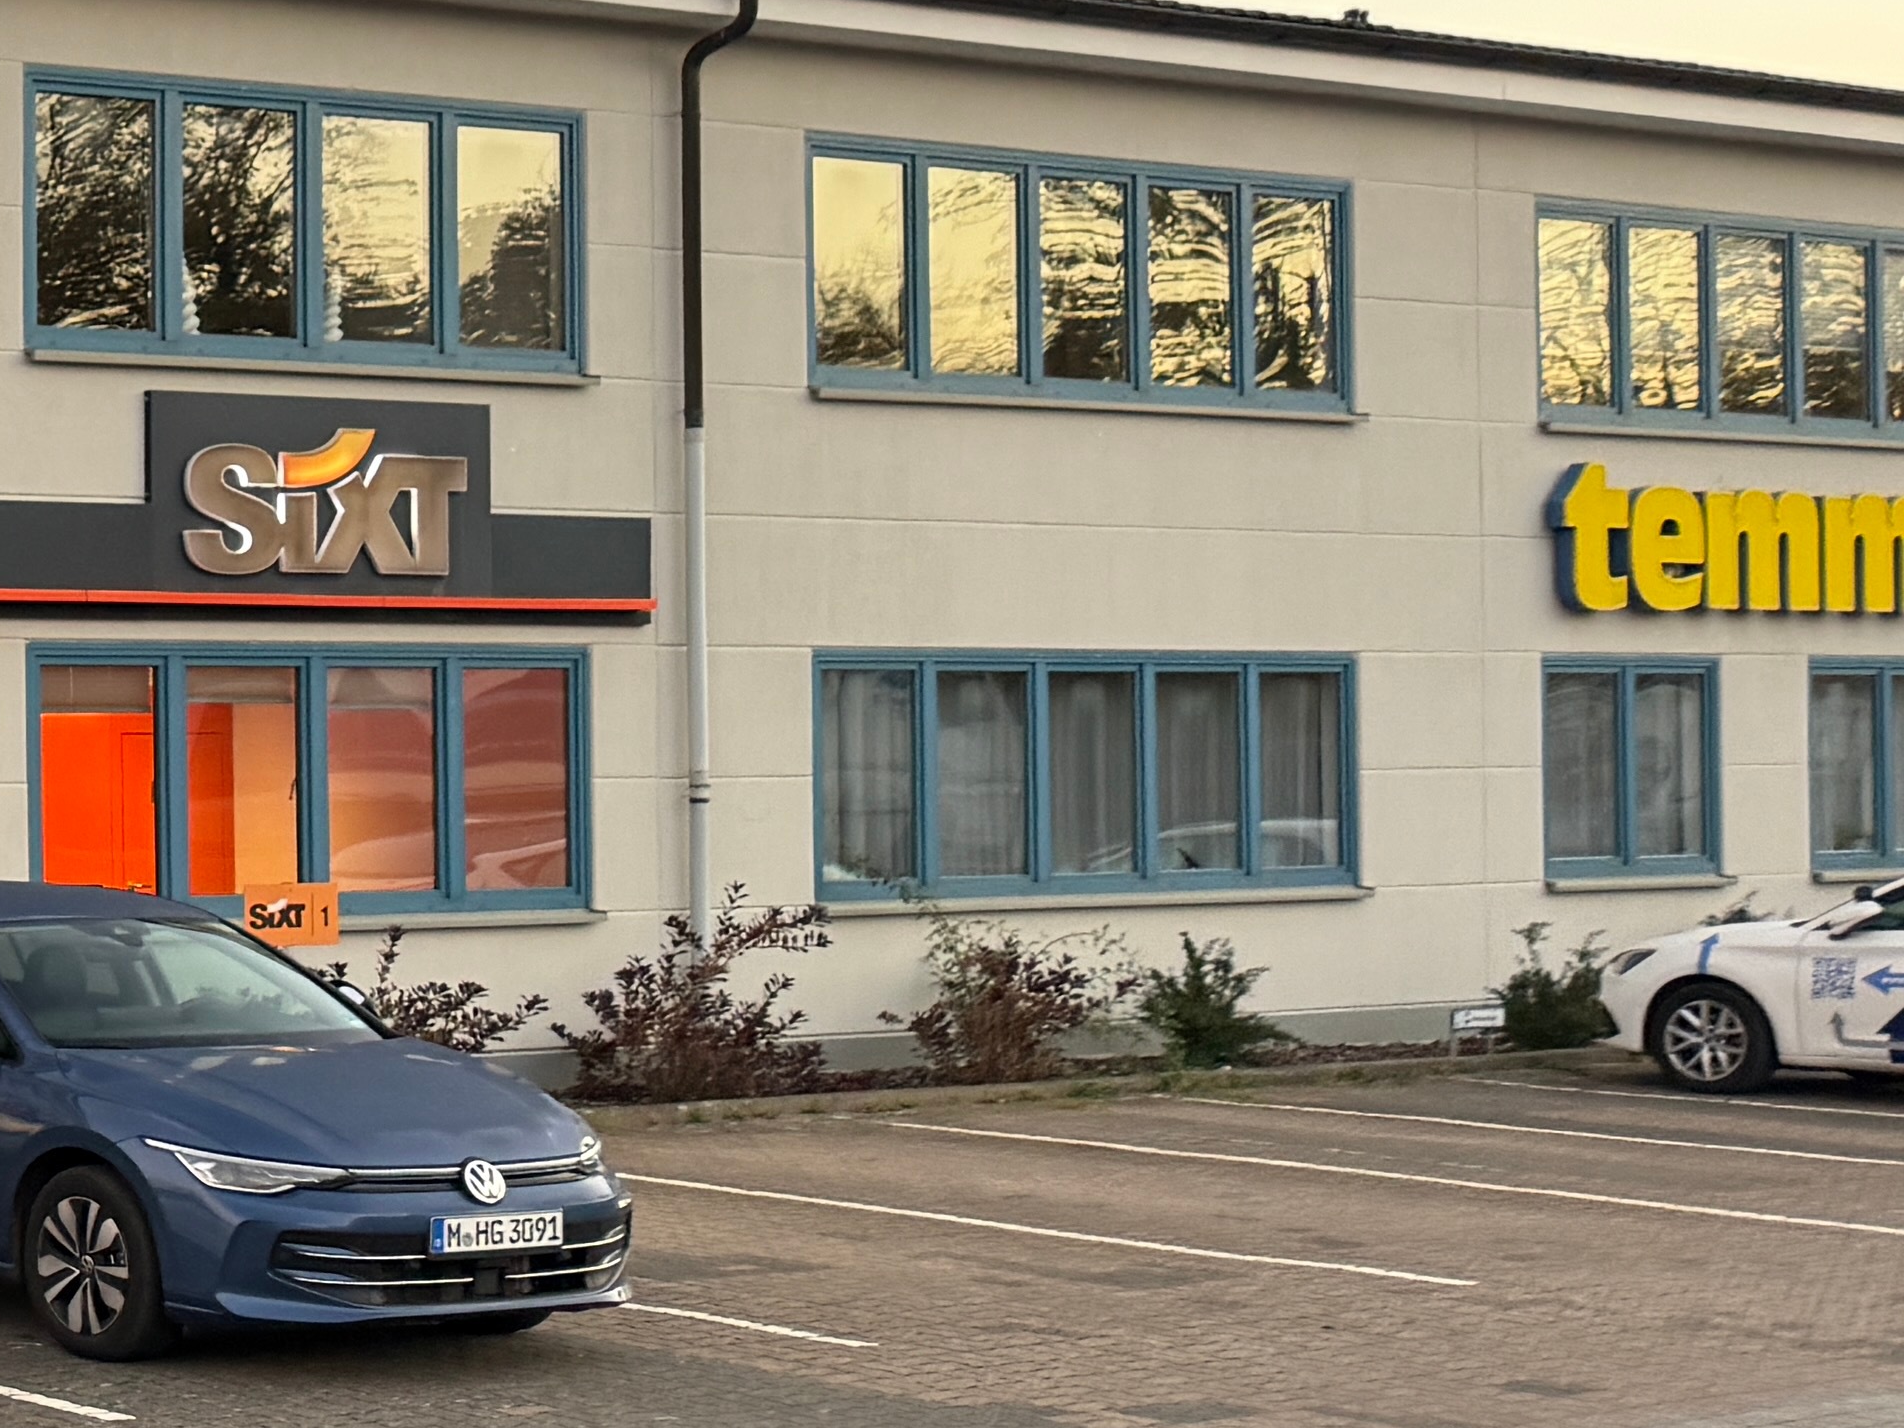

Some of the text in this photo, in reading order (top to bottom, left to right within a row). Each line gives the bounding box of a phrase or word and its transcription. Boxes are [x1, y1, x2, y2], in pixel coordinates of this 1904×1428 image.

[320, 905, 329, 927] 1
[447, 1215, 560, 1248] M HG 3091
